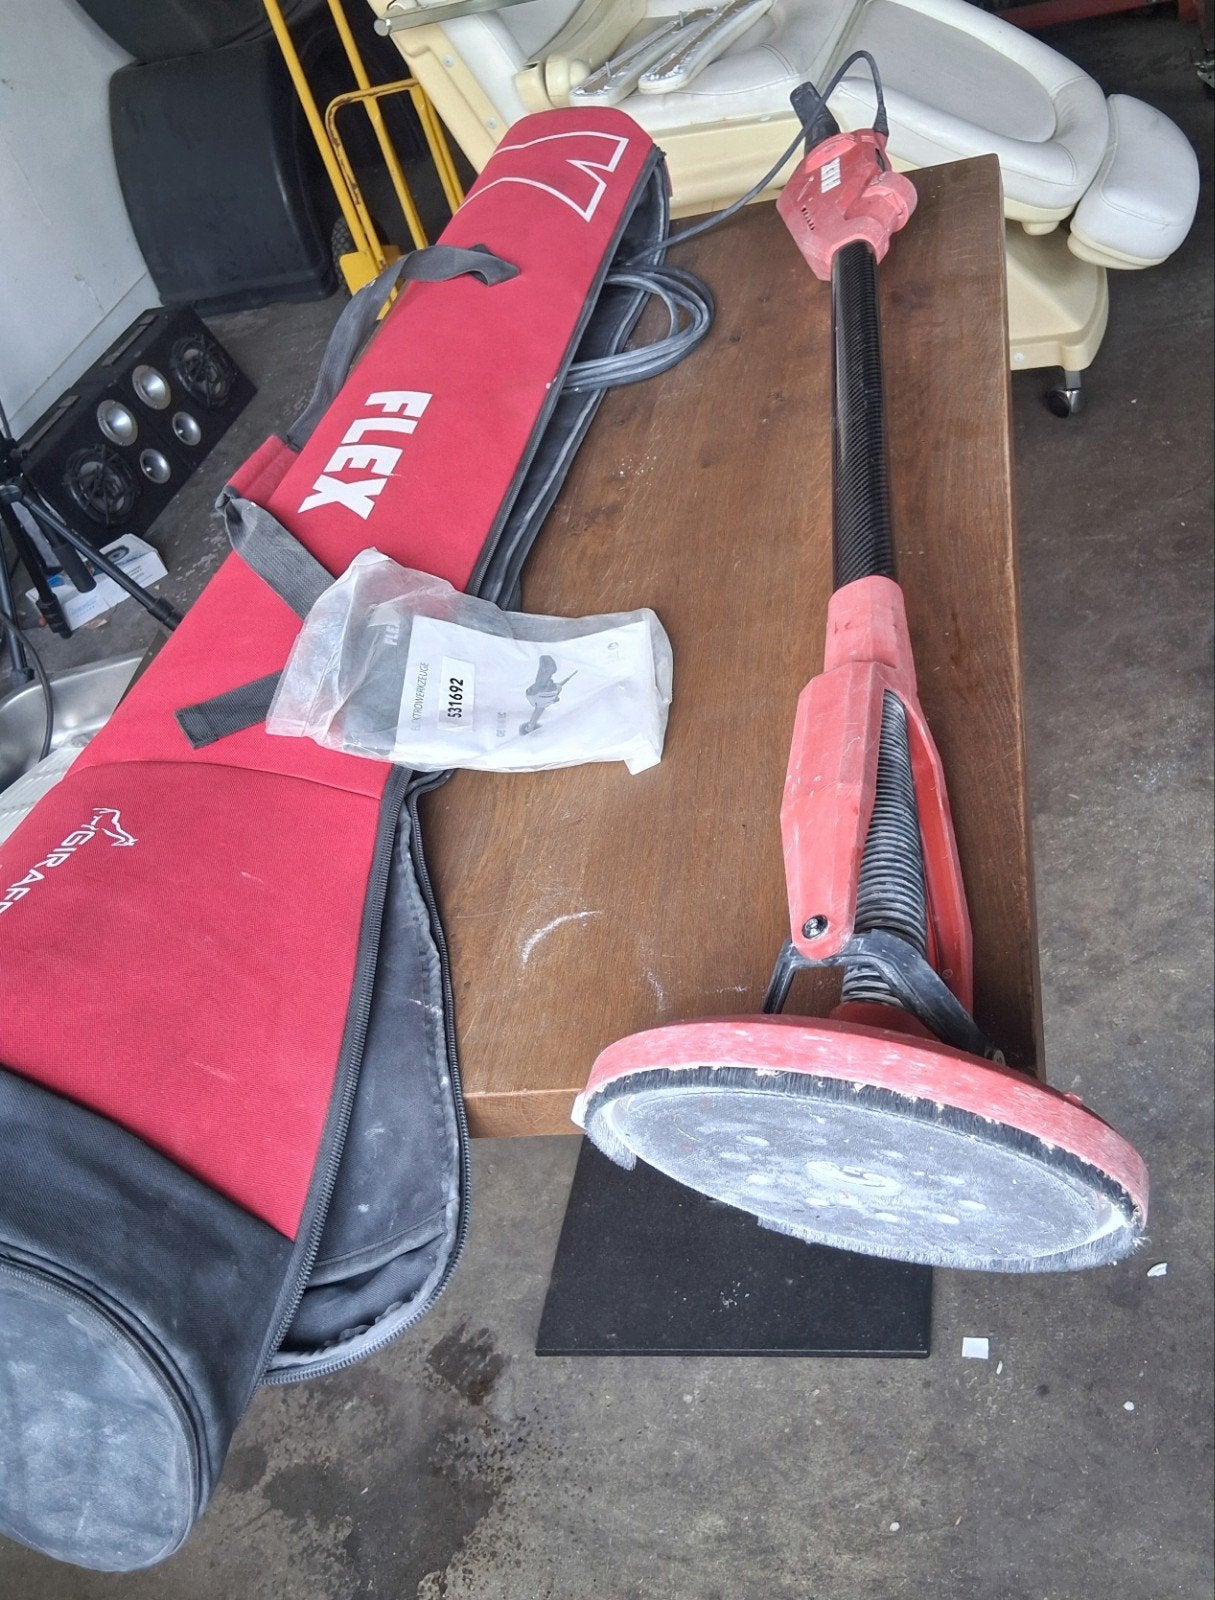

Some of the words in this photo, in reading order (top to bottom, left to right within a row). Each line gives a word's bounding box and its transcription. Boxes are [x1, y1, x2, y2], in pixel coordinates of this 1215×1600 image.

[297, 390, 433, 520] FLEX
[384, 623, 401, 645] FLE
[447, 677, 464, 718] 531692
